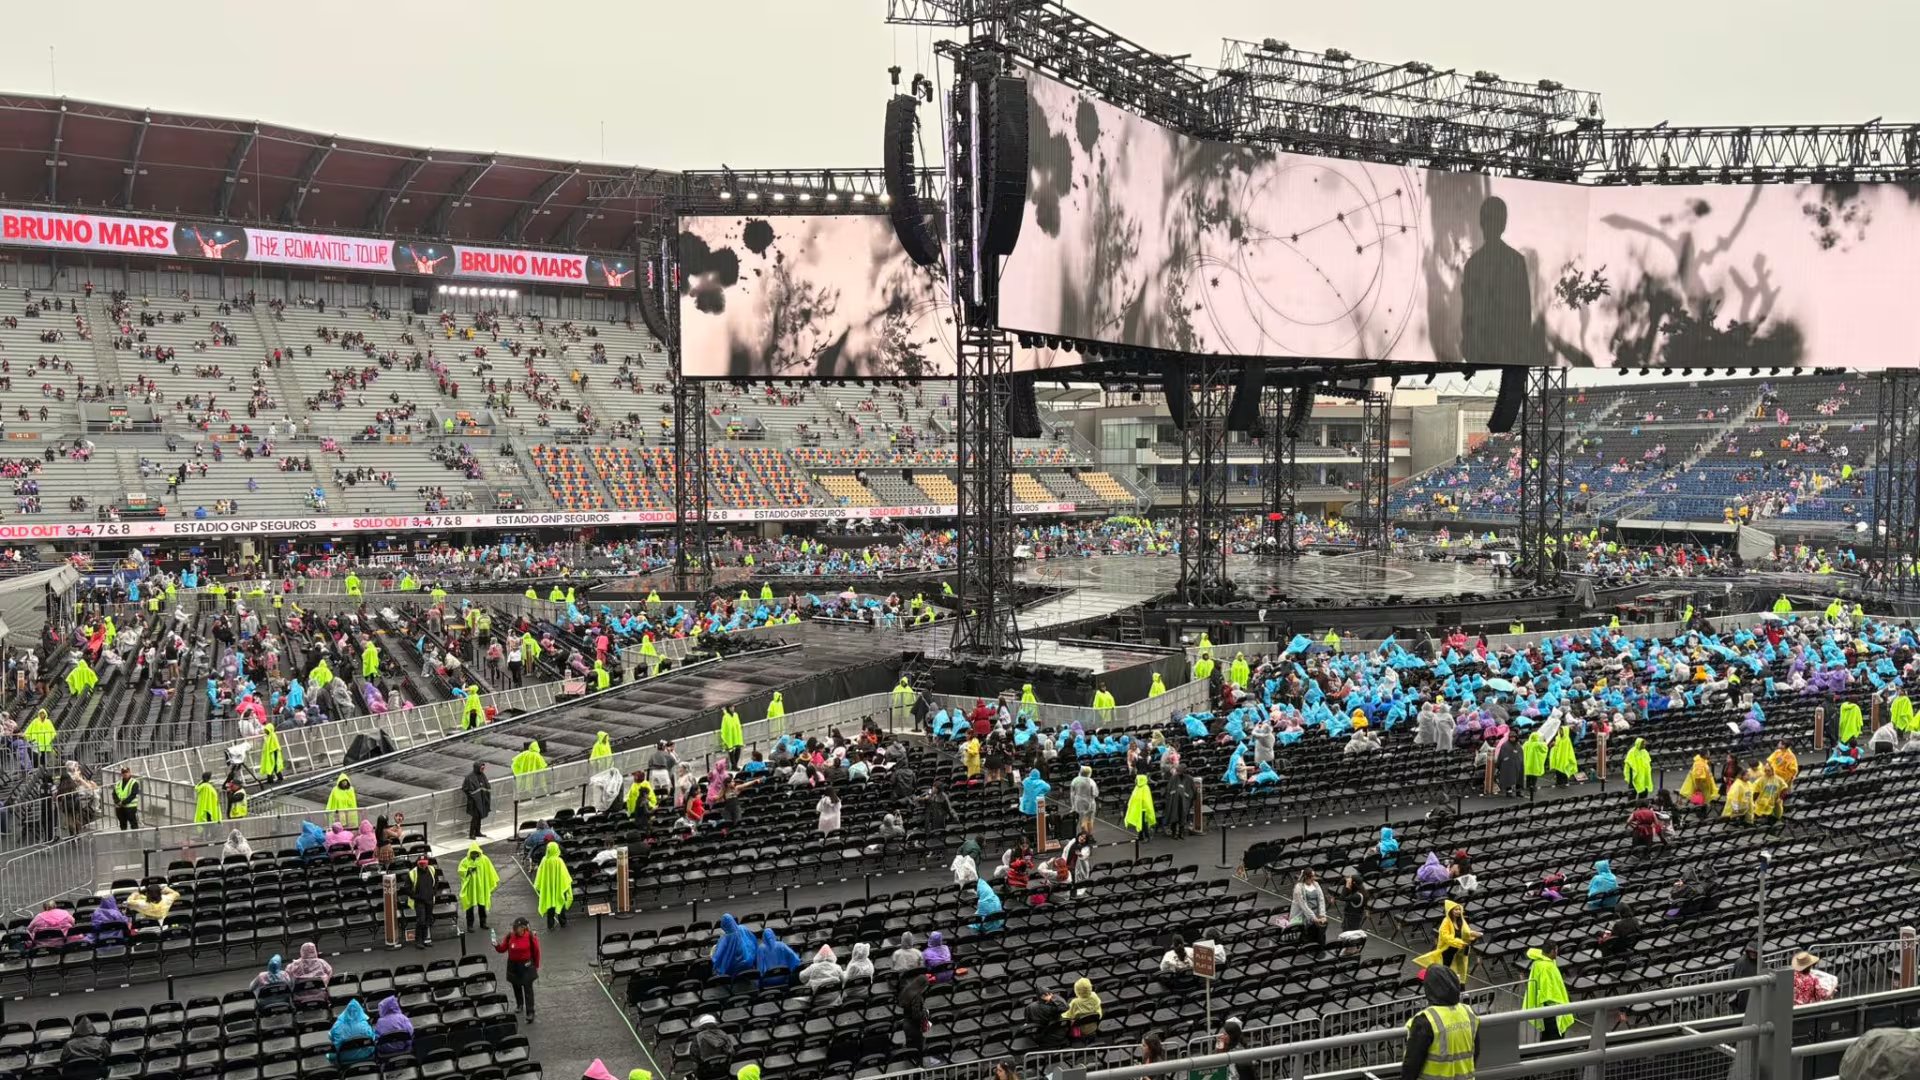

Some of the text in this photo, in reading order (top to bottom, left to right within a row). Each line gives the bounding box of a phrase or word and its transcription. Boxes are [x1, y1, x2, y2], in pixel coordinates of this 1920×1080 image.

[3, 215, 169, 249] BRUNO MARS
[253, 235, 388, 265] THE ROMANTIC TOUR
[461, 251, 583, 279] BRUNO MARS
[640, 512, 663, 521] SOLD
[721, 511, 728, 519] 8
[755, 509, 846, 519] ESTADIO GNP SEGUROS
[869, 508, 888, 516] SOLD
[889, 508, 905, 516] OUT
[353, 518, 382, 528] SOLD
[384, 518, 408, 527] OUT
[435, 517, 443, 526] 7
[444, 517, 453, 526] &
[455, 516, 462, 525] 8
[496, 513, 610, 524] ESTADIO GNP SEGUROS
[31, 526, 61, 537] OUT
[97, 525, 105, 535] 7
[107, 525, 118, 534] &
[121, 524, 130, 534] 8
[174, 520, 316, 533] ESTADIO GNP SEGUROS
